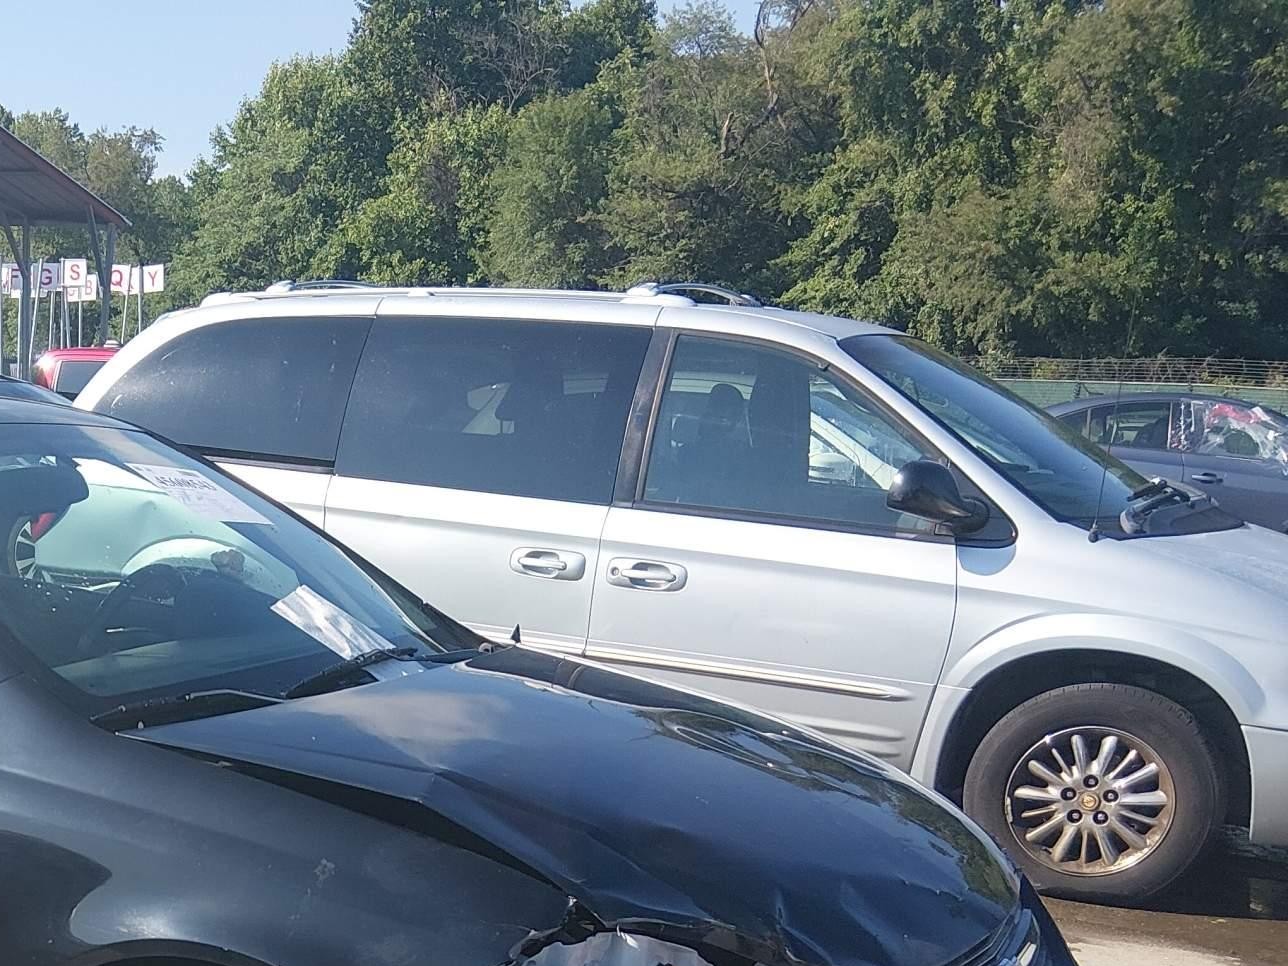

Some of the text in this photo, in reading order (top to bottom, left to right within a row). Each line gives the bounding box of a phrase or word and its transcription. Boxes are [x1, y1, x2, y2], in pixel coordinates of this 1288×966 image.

[70, 264, 81, 281] S
[111, 269, 123, 287] Q
[147, 270, 158, 288] Y
[85, 280, 93, 296] B
